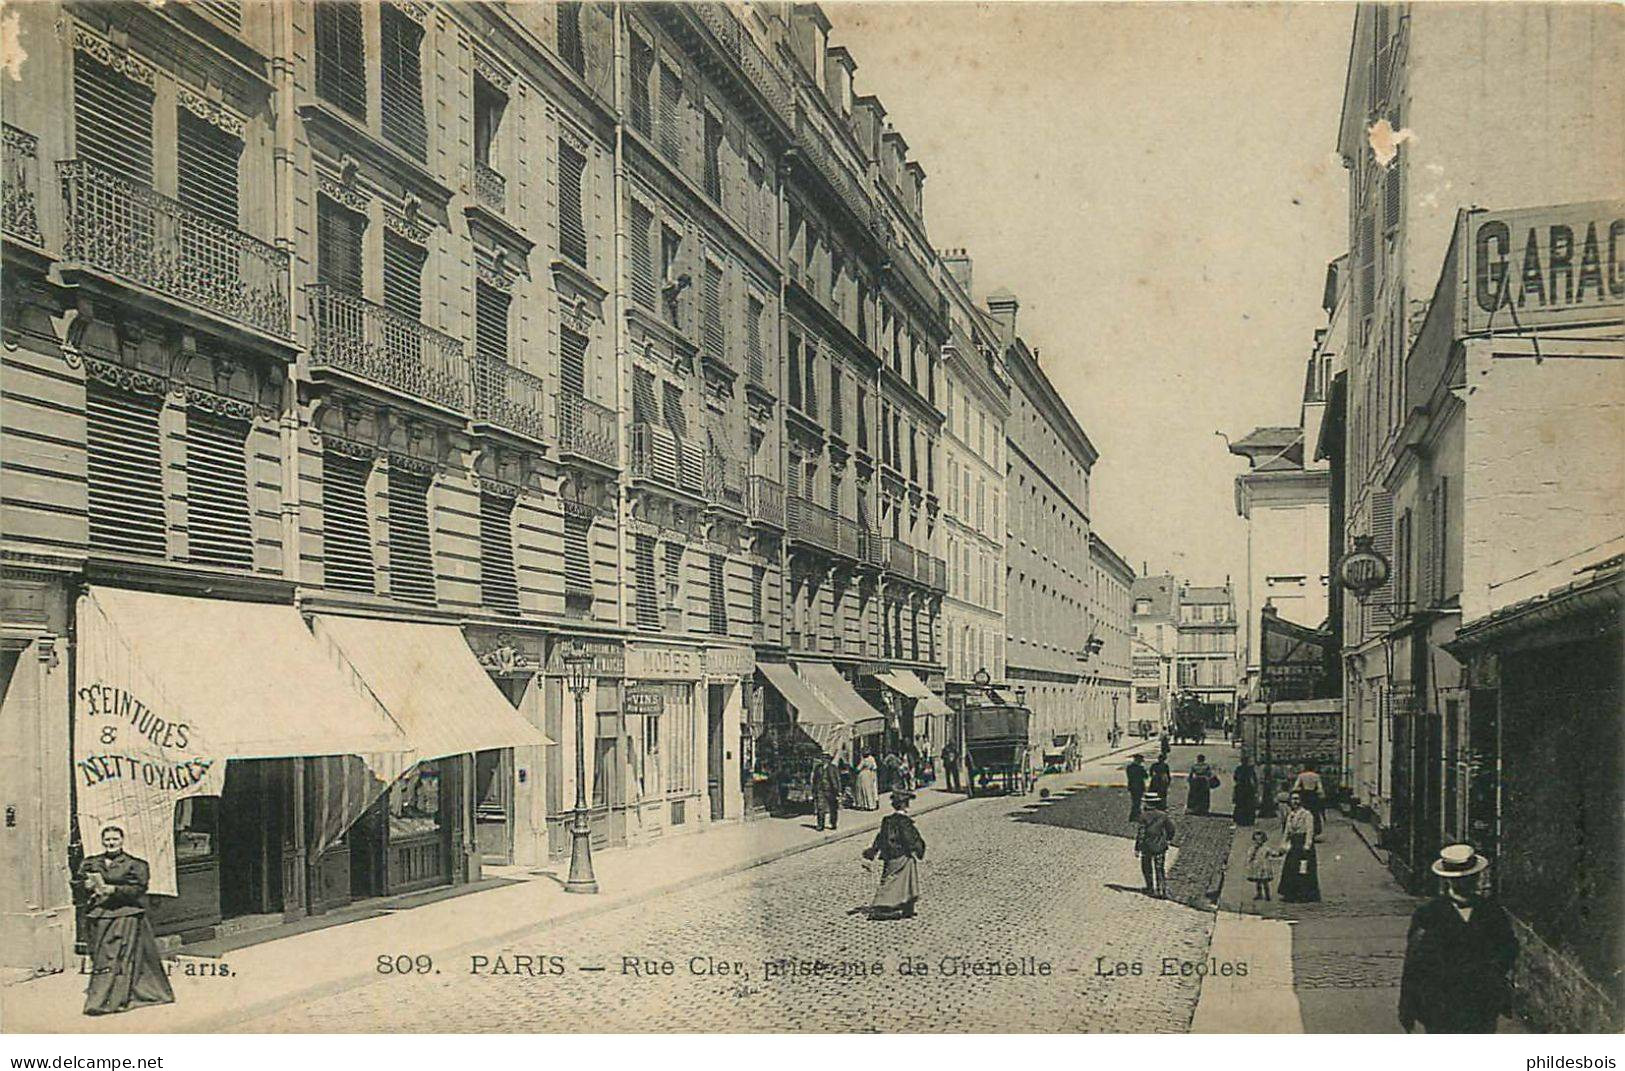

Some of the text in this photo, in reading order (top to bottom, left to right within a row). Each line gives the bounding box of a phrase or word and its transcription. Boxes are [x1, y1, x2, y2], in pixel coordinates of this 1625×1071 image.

[642, 650, 691, 674] MODES
[631, 693, 660, 705] VINS
[77, 684, 190, 749] TEINTURES
[100, 726, 117, 745] &
